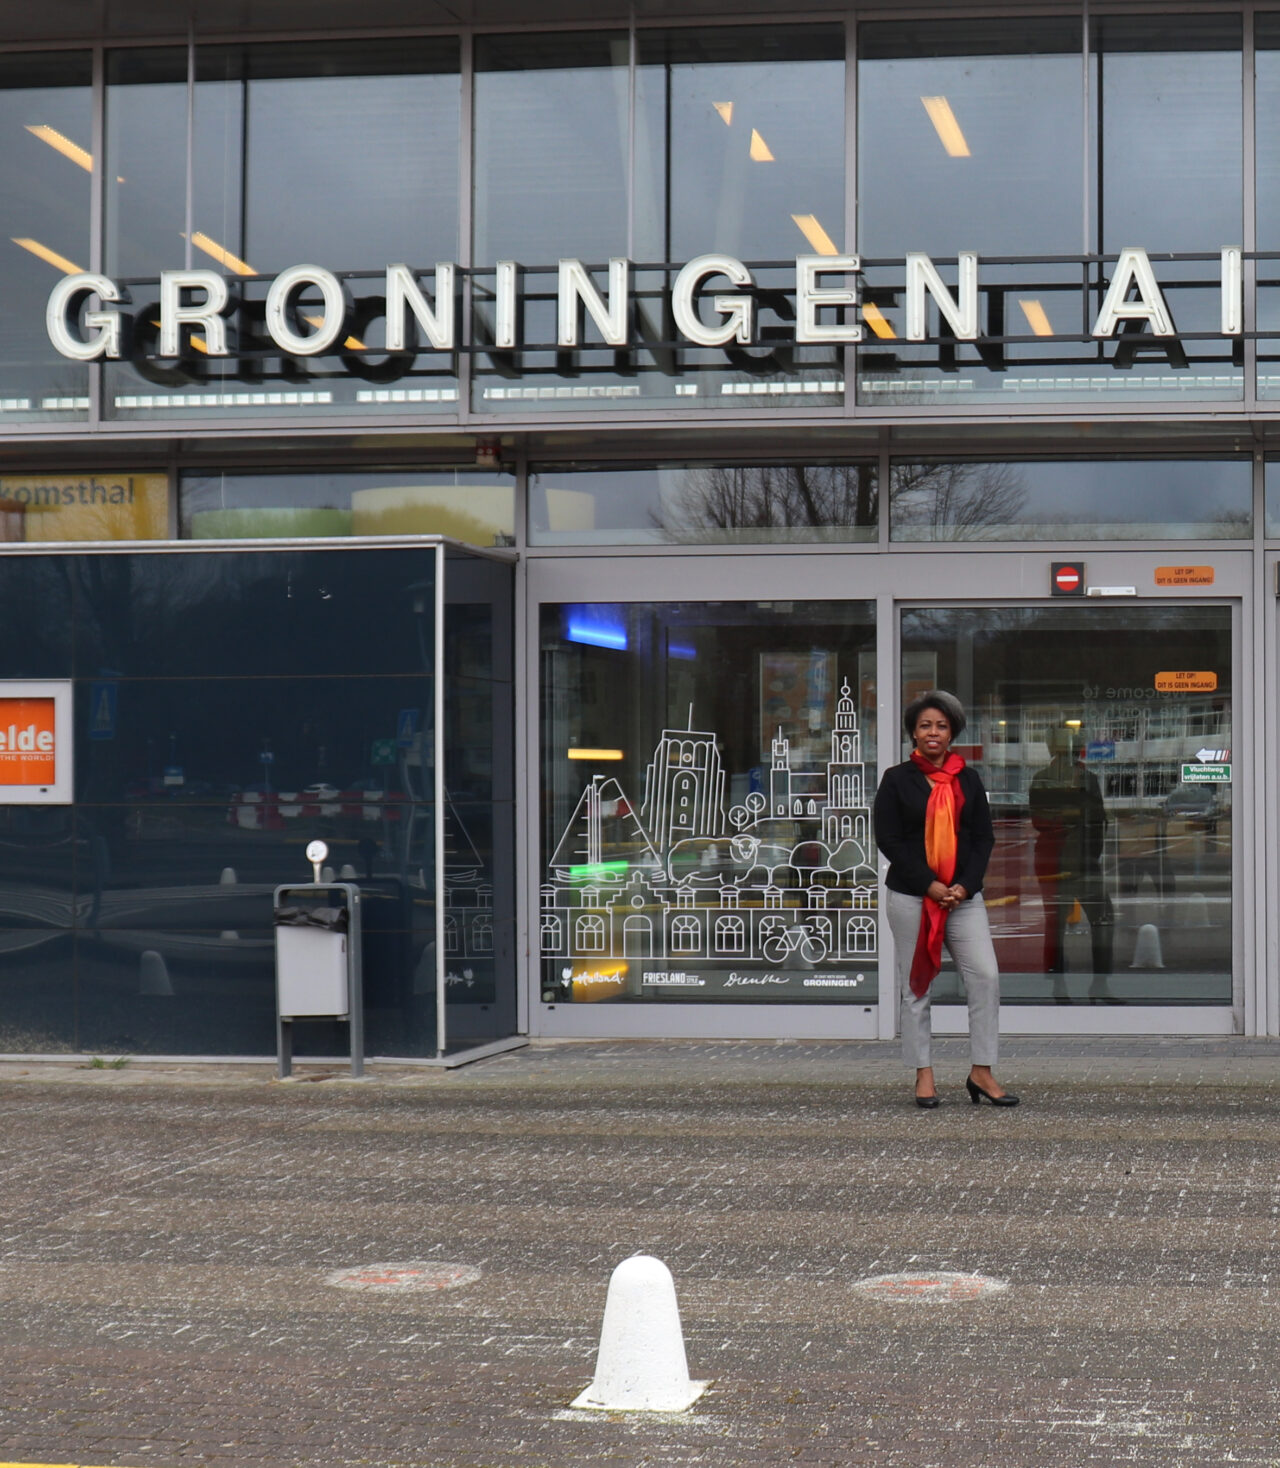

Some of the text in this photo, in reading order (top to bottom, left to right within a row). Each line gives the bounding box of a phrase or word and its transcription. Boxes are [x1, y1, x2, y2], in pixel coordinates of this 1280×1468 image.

[47, 251, 979, 360] GRONINGEN
[1189, 766, 1224, 774] Vluchtweg
[1184, 773, 1211, 781] vrijlaten
[642, 972, 686, 984] FRIESLAND
[803, 979, 857, 987] GRONINGEN
